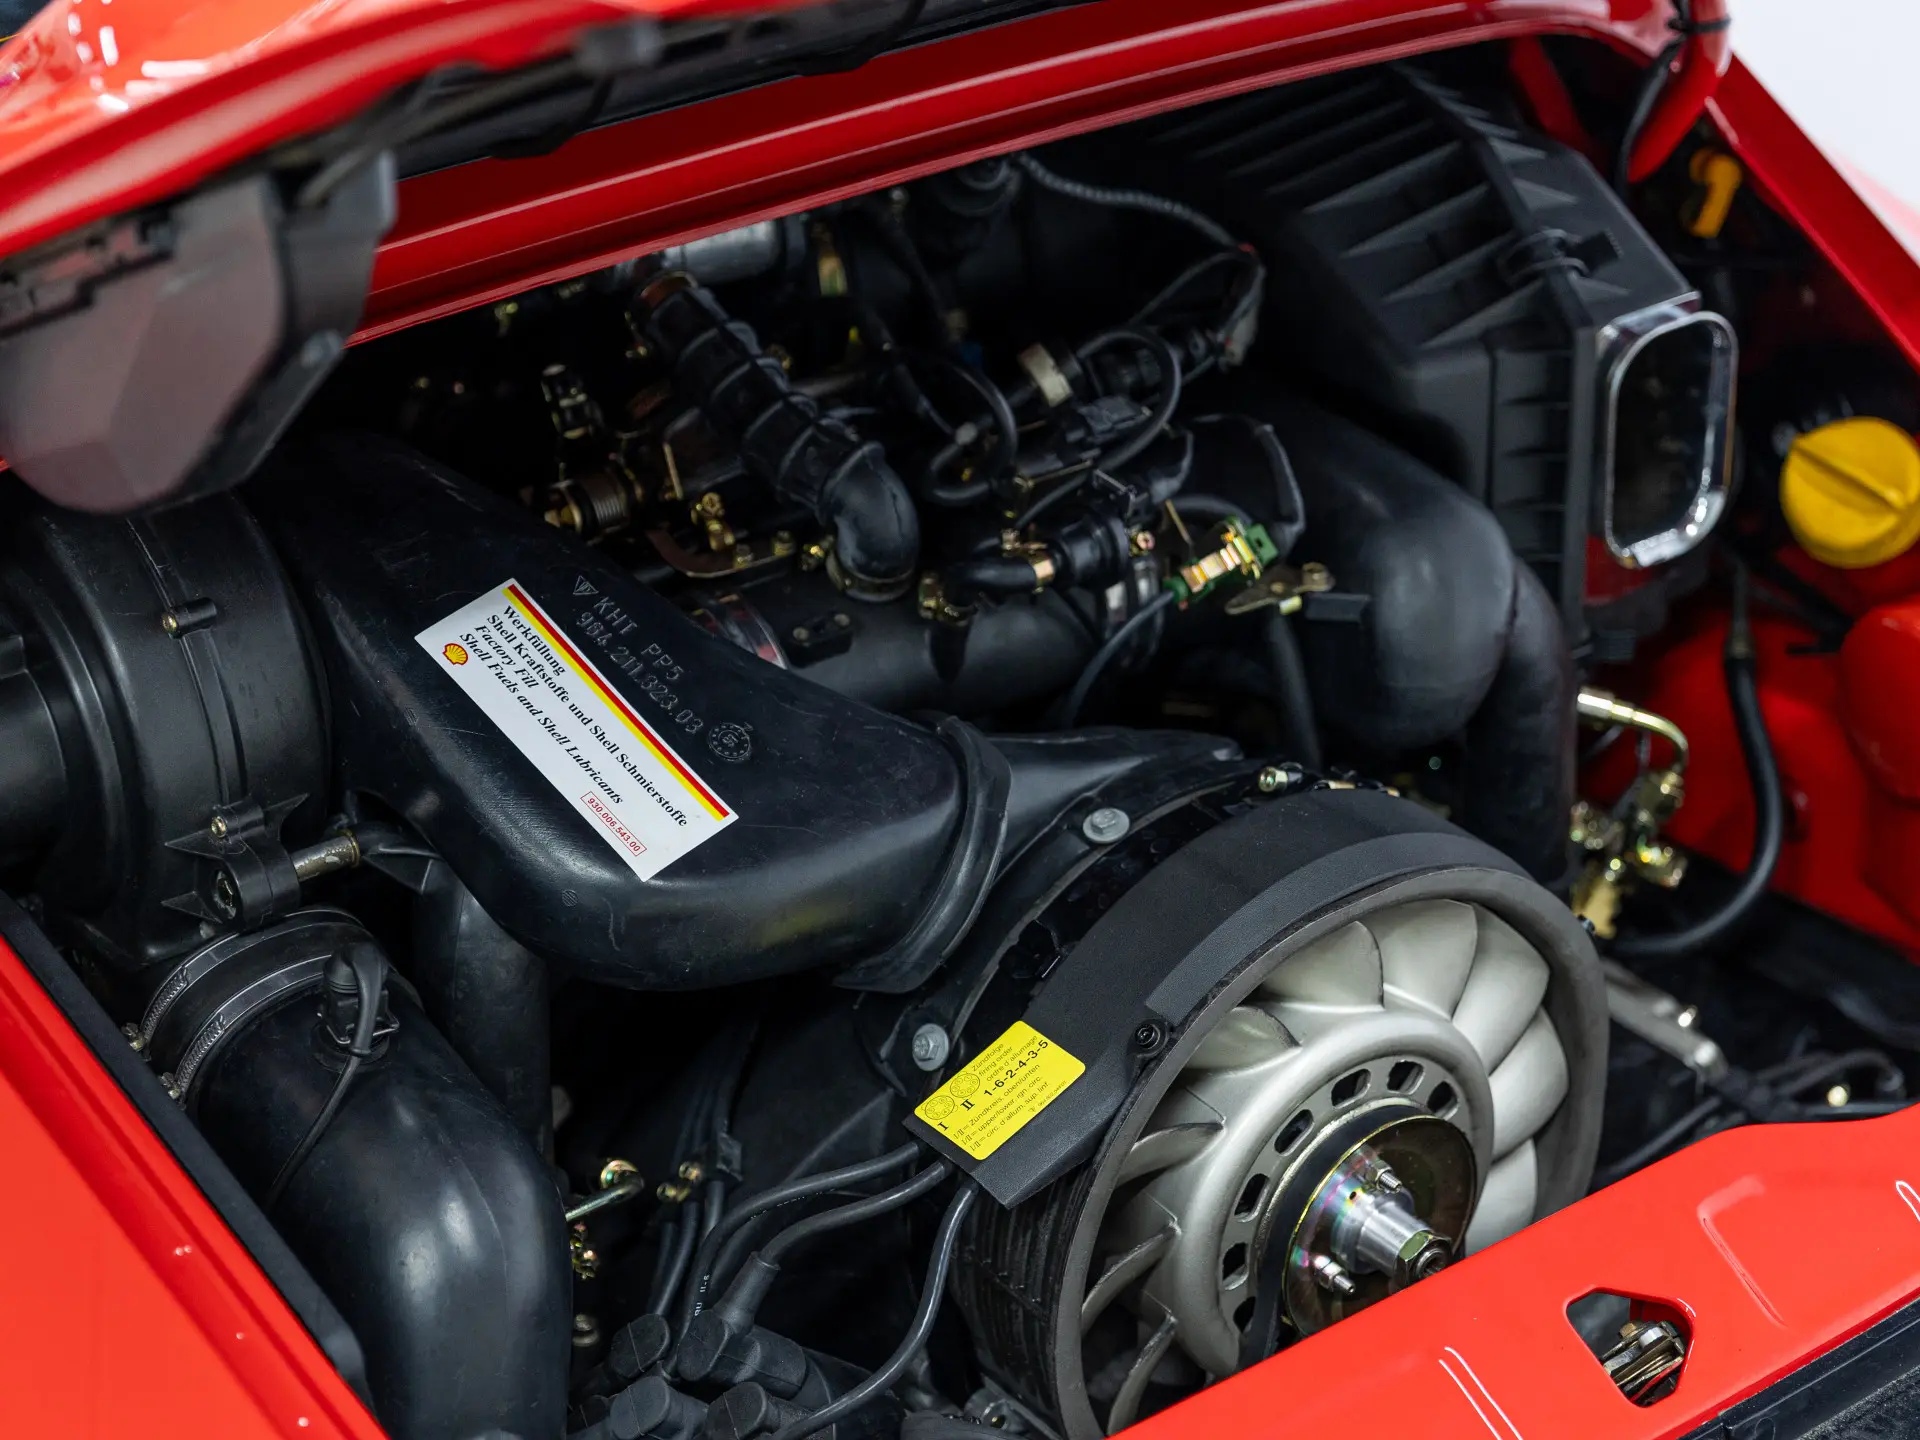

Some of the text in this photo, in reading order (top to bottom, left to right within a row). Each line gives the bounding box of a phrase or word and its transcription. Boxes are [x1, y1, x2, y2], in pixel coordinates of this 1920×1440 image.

[474, 624, 540, 689] Factory Fill
[503, 605, 566, 677] Werkfüllung
[460, 633, 624, 804] Shell Fuels and Shell Lubricants
[487, 614, 688, 827] Shell Kraftstoffe und Shell Schmierstoffe
[587, 797, 641, 852] 930.006.543.00
[983, 1039, 1049, 1097] 1-6-2-4-3-5
